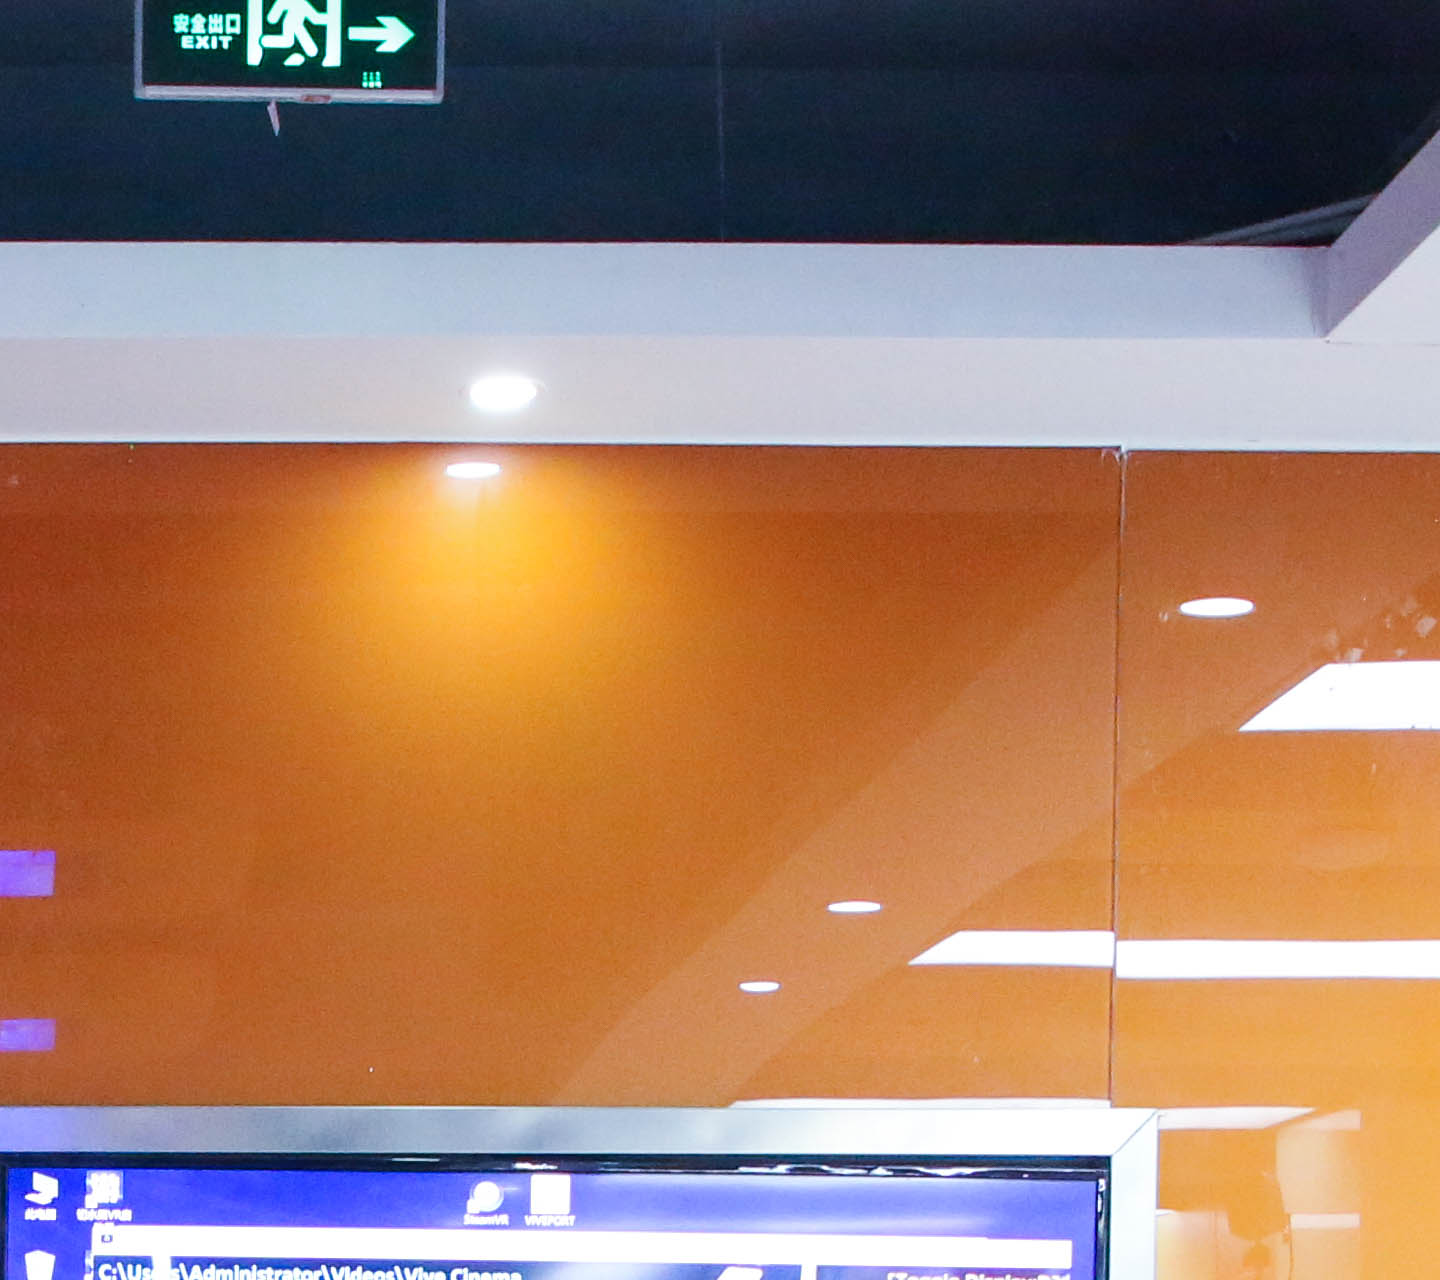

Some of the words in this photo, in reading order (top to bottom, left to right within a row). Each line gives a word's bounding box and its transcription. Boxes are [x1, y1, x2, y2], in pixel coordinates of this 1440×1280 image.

[173, 13, 241, 35] 安全出口
[181, 36, 232, 49] EXIT
